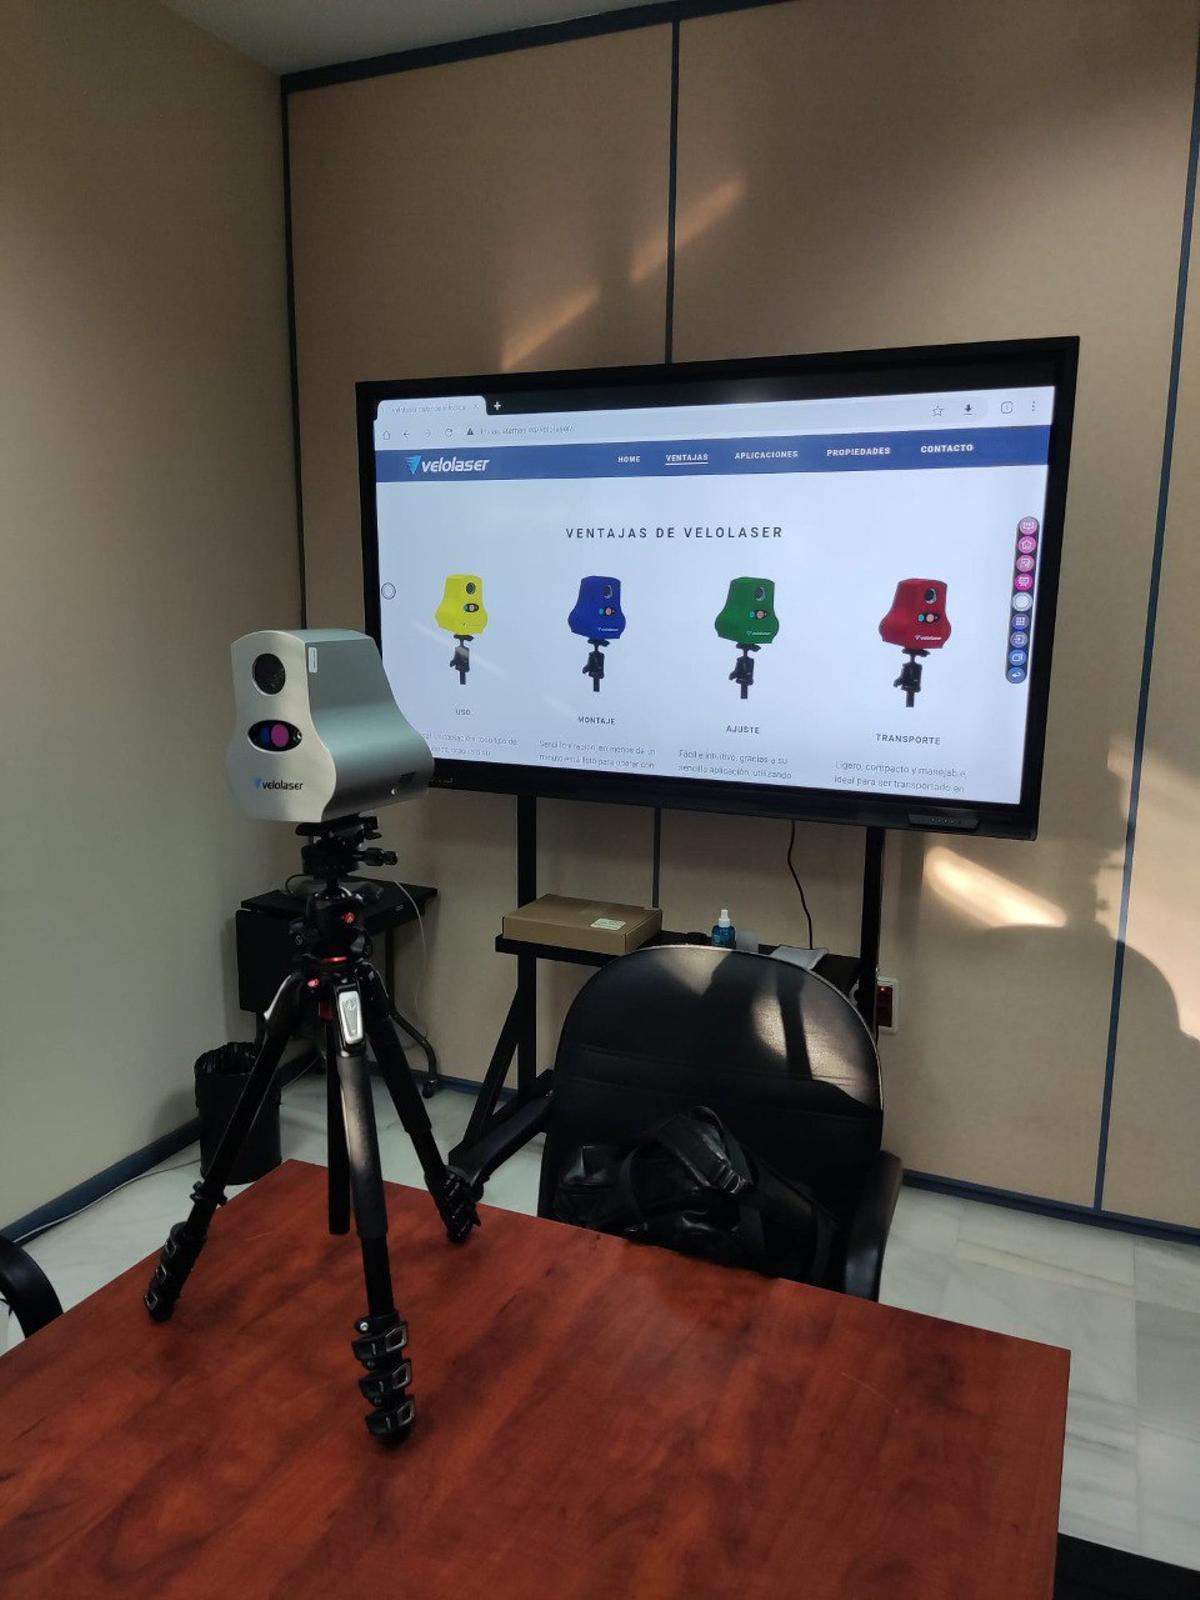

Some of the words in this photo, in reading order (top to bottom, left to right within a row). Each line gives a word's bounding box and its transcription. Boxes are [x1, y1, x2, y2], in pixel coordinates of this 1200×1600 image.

[617, 455, 641, 464] HOME
[665, 453, 709, 463] VENTAJAS
[734, 450, 799, 460] APLICACIONES
[826, 446, 891, 457] PROPIEDADES
[920, 443, 974, 454] CONTACTO
[421, 456, 490, 473] velolaser
[565, 527, 648, 539] VENTAJAS
[656, 527, 675, 539] DE
[684, 526, 783, 539] VELOLASER
[455, 708, 471, 716] USO
[577, 715, 616, 726] MONTAJE
[726, 725, 761, 735] AJUSTE
[875, 733, 941, 746] TRANSPORTE
[918, 766, 967, 779] manejabe,
[262, 779, 304, 791] velolaser
